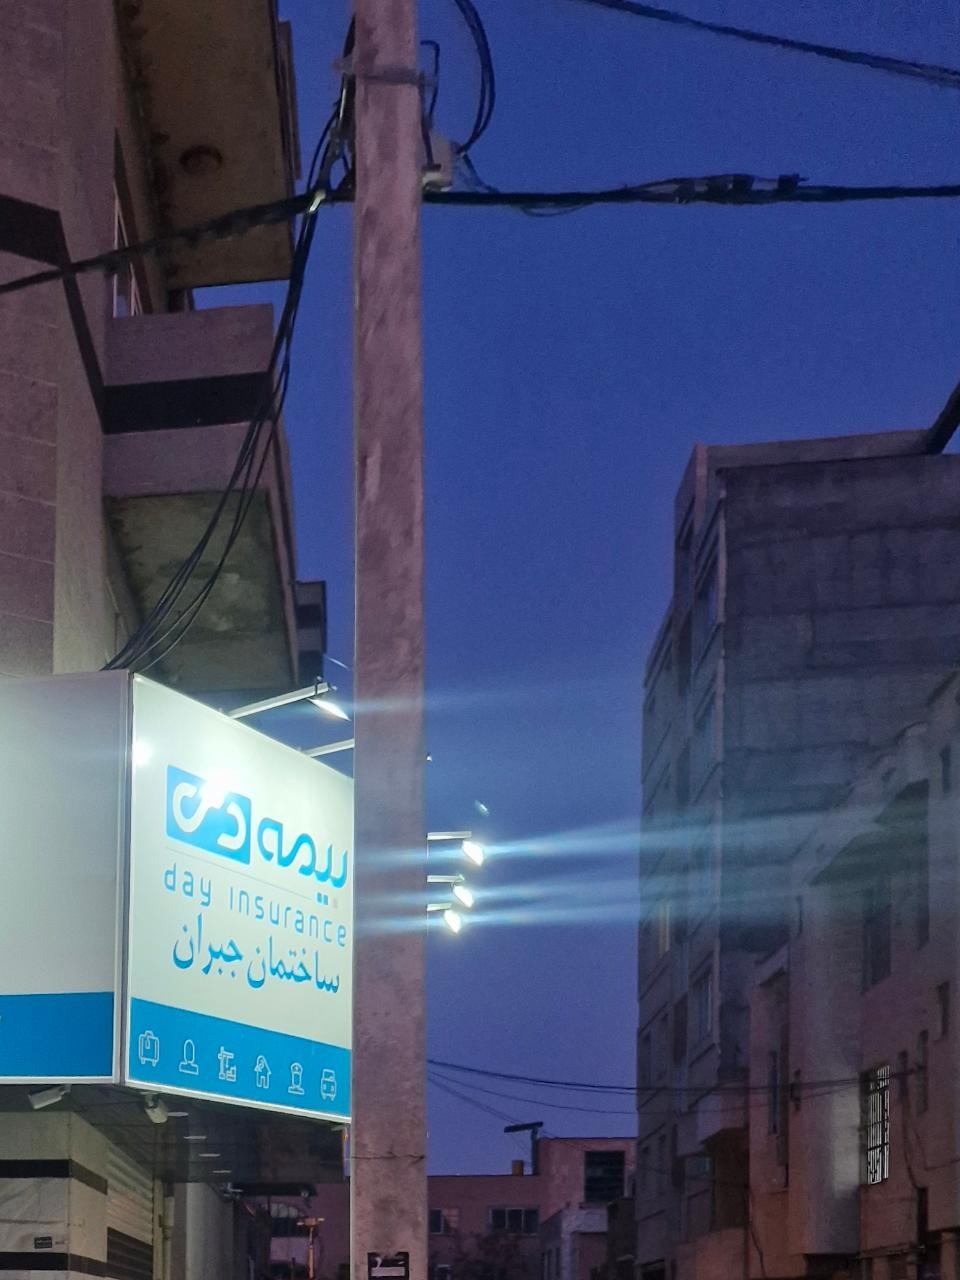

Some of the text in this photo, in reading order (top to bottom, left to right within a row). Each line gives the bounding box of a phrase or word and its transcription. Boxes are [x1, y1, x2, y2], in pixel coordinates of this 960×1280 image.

[164, 863, 347, 947] day insurance
[257, 817, 348, 909] بیمه
[172, 912, 340, 993] ساختمان جبران
